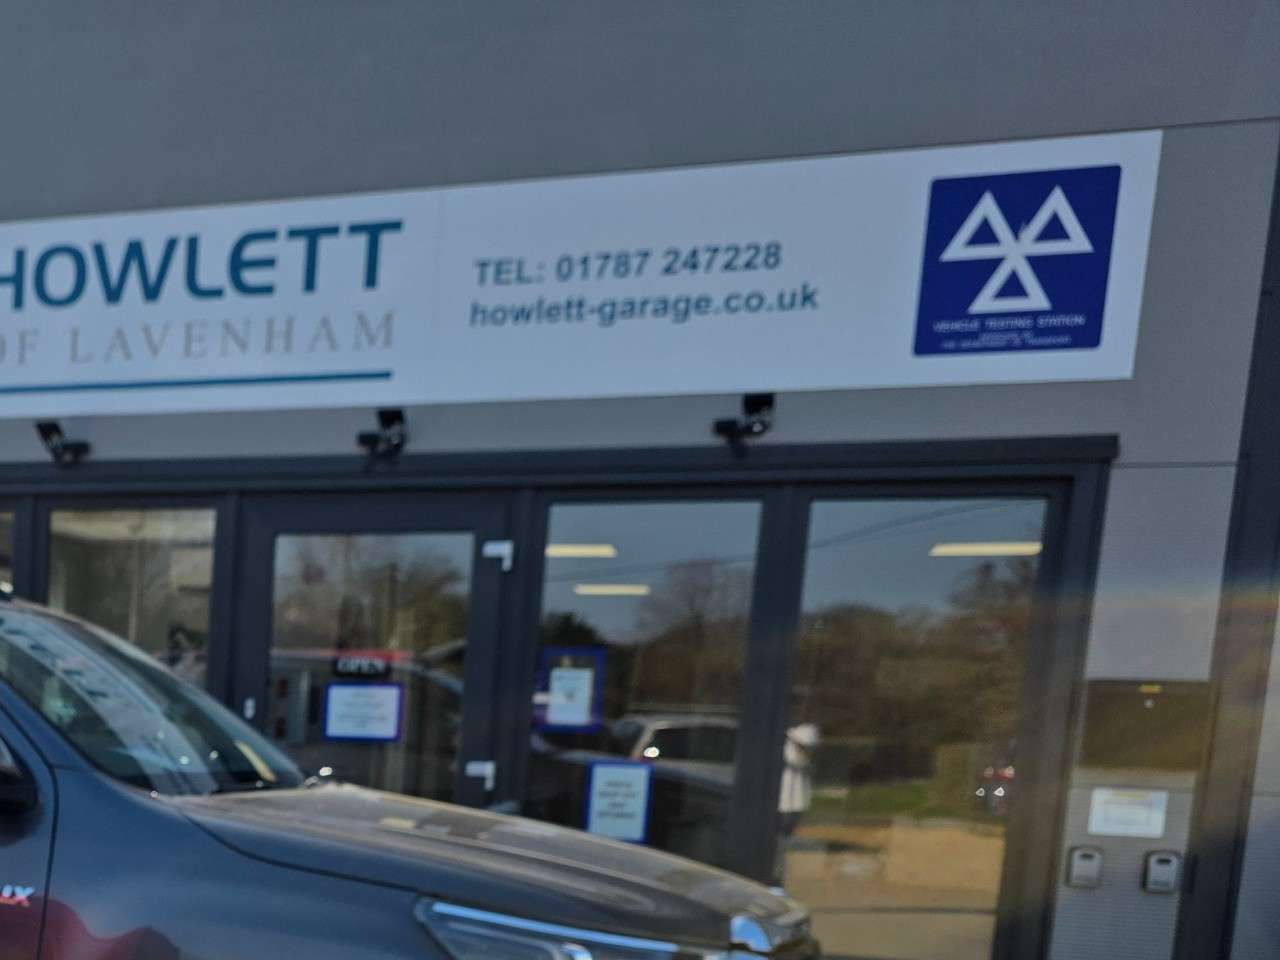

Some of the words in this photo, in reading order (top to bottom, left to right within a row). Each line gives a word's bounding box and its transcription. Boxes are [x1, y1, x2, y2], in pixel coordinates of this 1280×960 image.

[476, 258, 546, 287] TEL:
[556, 249, 651, 282] 01787
[662, 241, 783, 276] 247228
[470, 280, 818, 328] howlett-garage.co.uk
[1036, 314, 1086, 328] STATION
[69, 311, 395, 364] LAVENHAM
